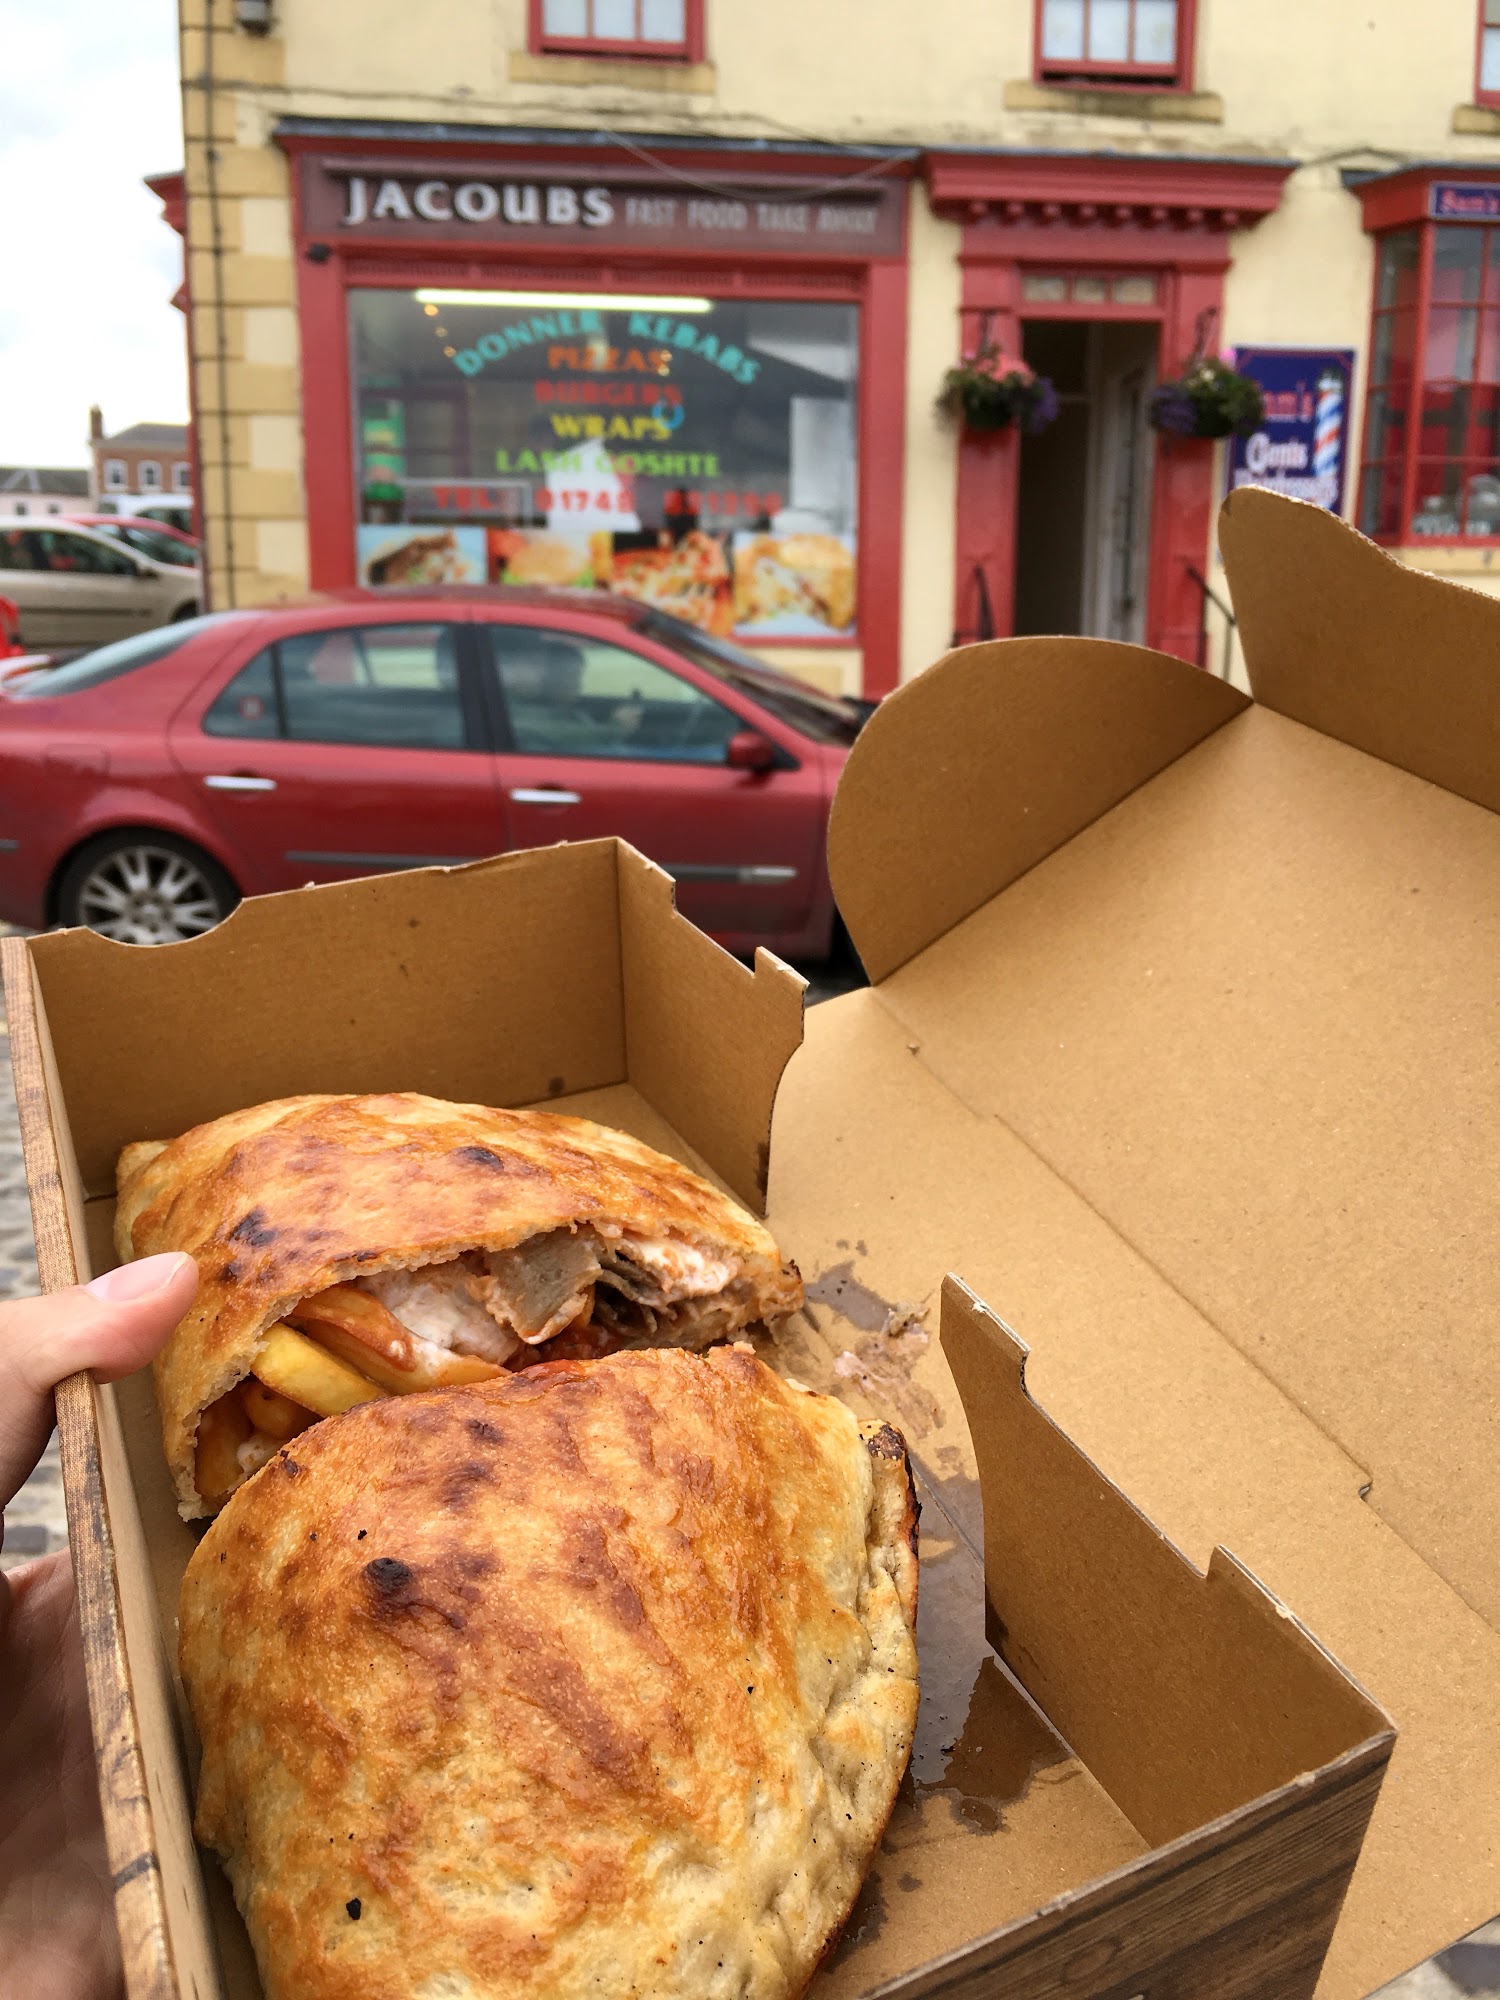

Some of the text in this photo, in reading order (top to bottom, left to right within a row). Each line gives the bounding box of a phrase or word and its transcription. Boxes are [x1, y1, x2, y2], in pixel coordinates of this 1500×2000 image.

[344, 177, 615, 227] JACOUBS
[625, 198, 676, 228] FAST
[687, 199, 748, 230] FOOD
[757, 202, 808, 234] TAKE
[452, 309, 762, 385] DONNER KEBABS
[546, 346, 669, 373] PIZZAS
[533, 379, 684, 406] BURGERS
[548, 414, 673, 441] WRAPS
